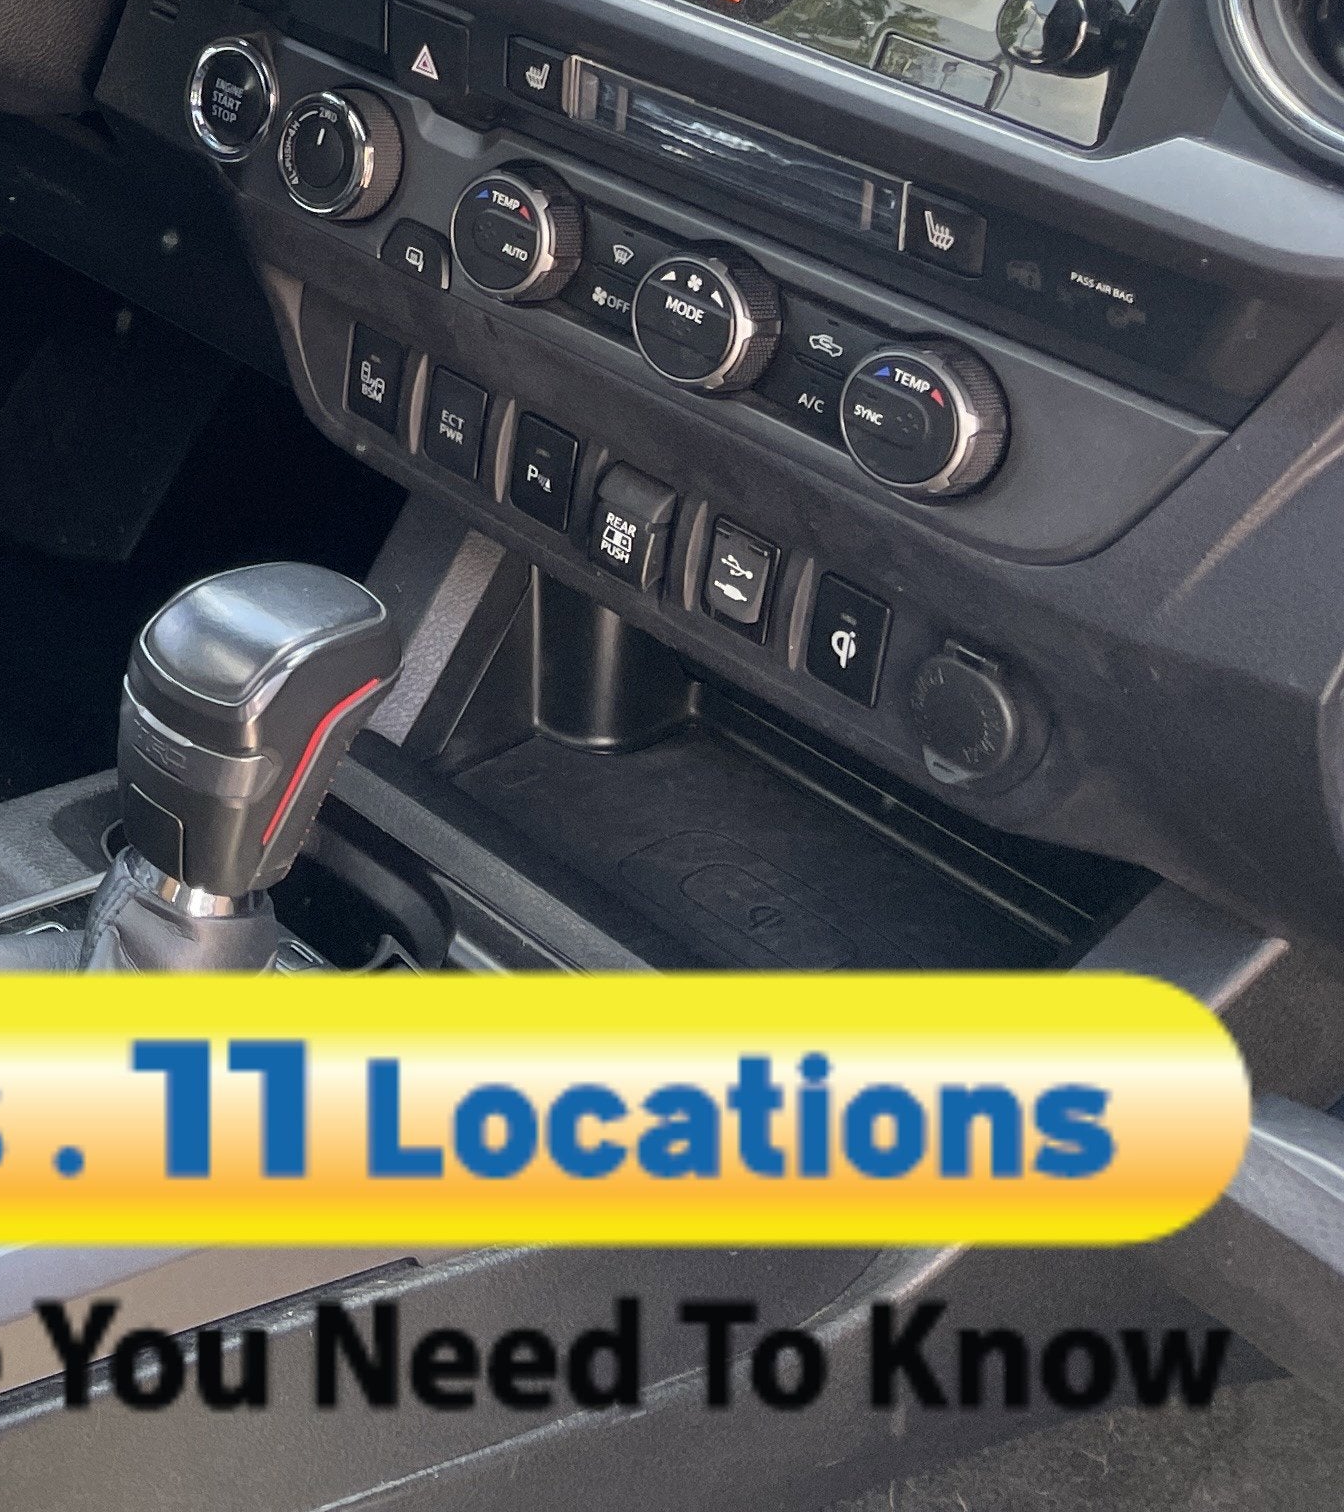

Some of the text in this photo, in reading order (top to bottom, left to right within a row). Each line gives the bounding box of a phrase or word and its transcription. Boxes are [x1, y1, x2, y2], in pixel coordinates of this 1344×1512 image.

[212, 90, 242, 112] START
[211, 104, 237, 123] STOP
[319, 107, 338, 123] 2WD
[491, 190, 520, 212] TEMP
[501, 243, 528, 262] AUTO
[1070, 271, 1095, 288] PASS
[1112, 287, 1134, 304] BAG
[606, 294, 631, 315] OFF
[664, 295, 706, 325] MODE
[893, 367, 931, 394] TEMP
[797, 392, 825, 414] A/C
[441, 409, 465, 430] ECT
[853, 404, 884, 426] SYNC
[438, 423, 464, 445] PWR
[605, 511, 637, 537] REAR
[600, 539, 630, 564] PUSH
